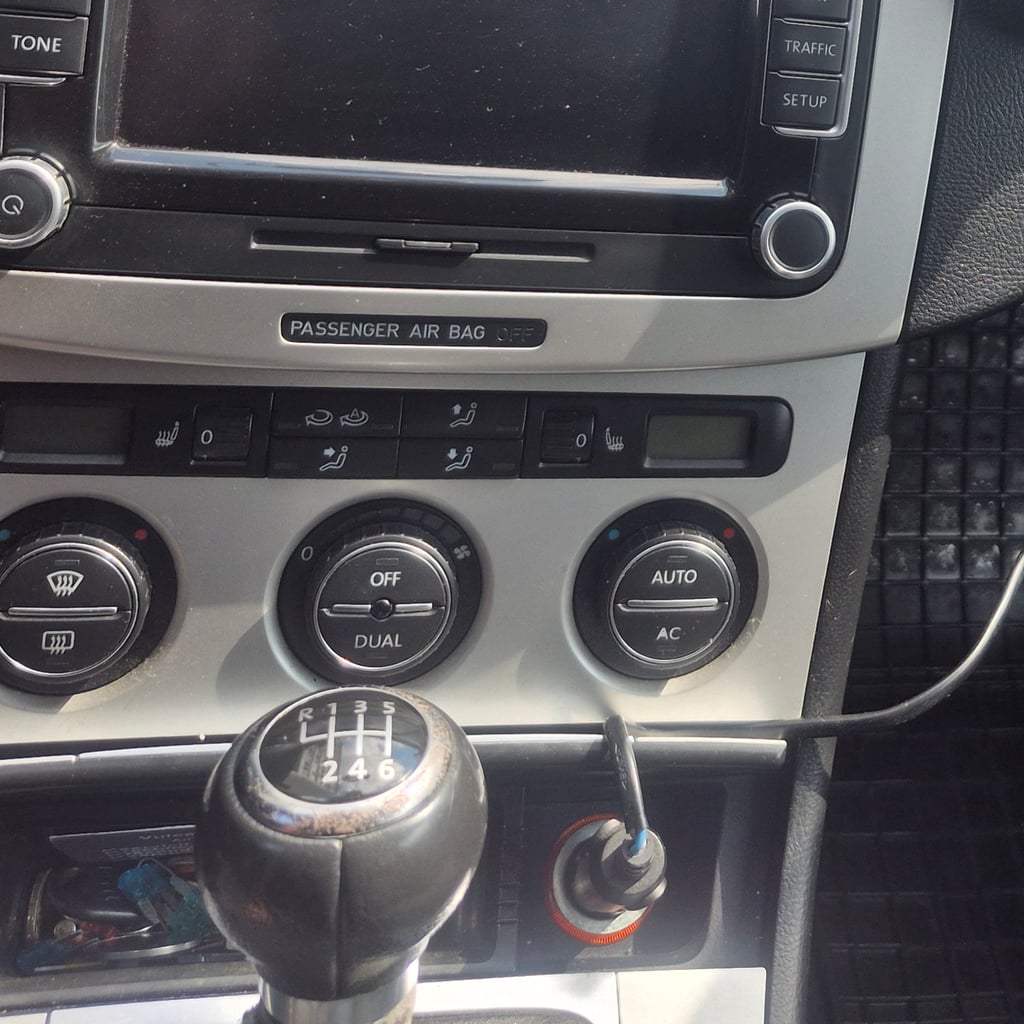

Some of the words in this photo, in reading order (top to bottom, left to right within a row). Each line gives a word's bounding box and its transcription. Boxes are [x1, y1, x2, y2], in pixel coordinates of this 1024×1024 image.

[11, 34, 62, 53] TONE
[784, 39, 837, 57] TRAFFIC
[783, 92, 828, 108] SETUP
[290, 320, 400, 339] PASSENGER
[409, 323, 440, 339] AIR
[449, 324, 486, 340] BAG
[370, 571, 402, 587] OFF
[651, 569, 698, 584] AUTO
[354, 633, 403, 649] DUAL
[656, 626, 682, 641] AC
[298, 707, 314, 722] R
[327, 702, 337, 715] 1
[354, 700, 367, 714] 3
[382, 701, 396, 715] 5
[321, 759, 338, 784] 2
[348, 757, 368, 780] 4
[379, 758, 395, 780] 6
